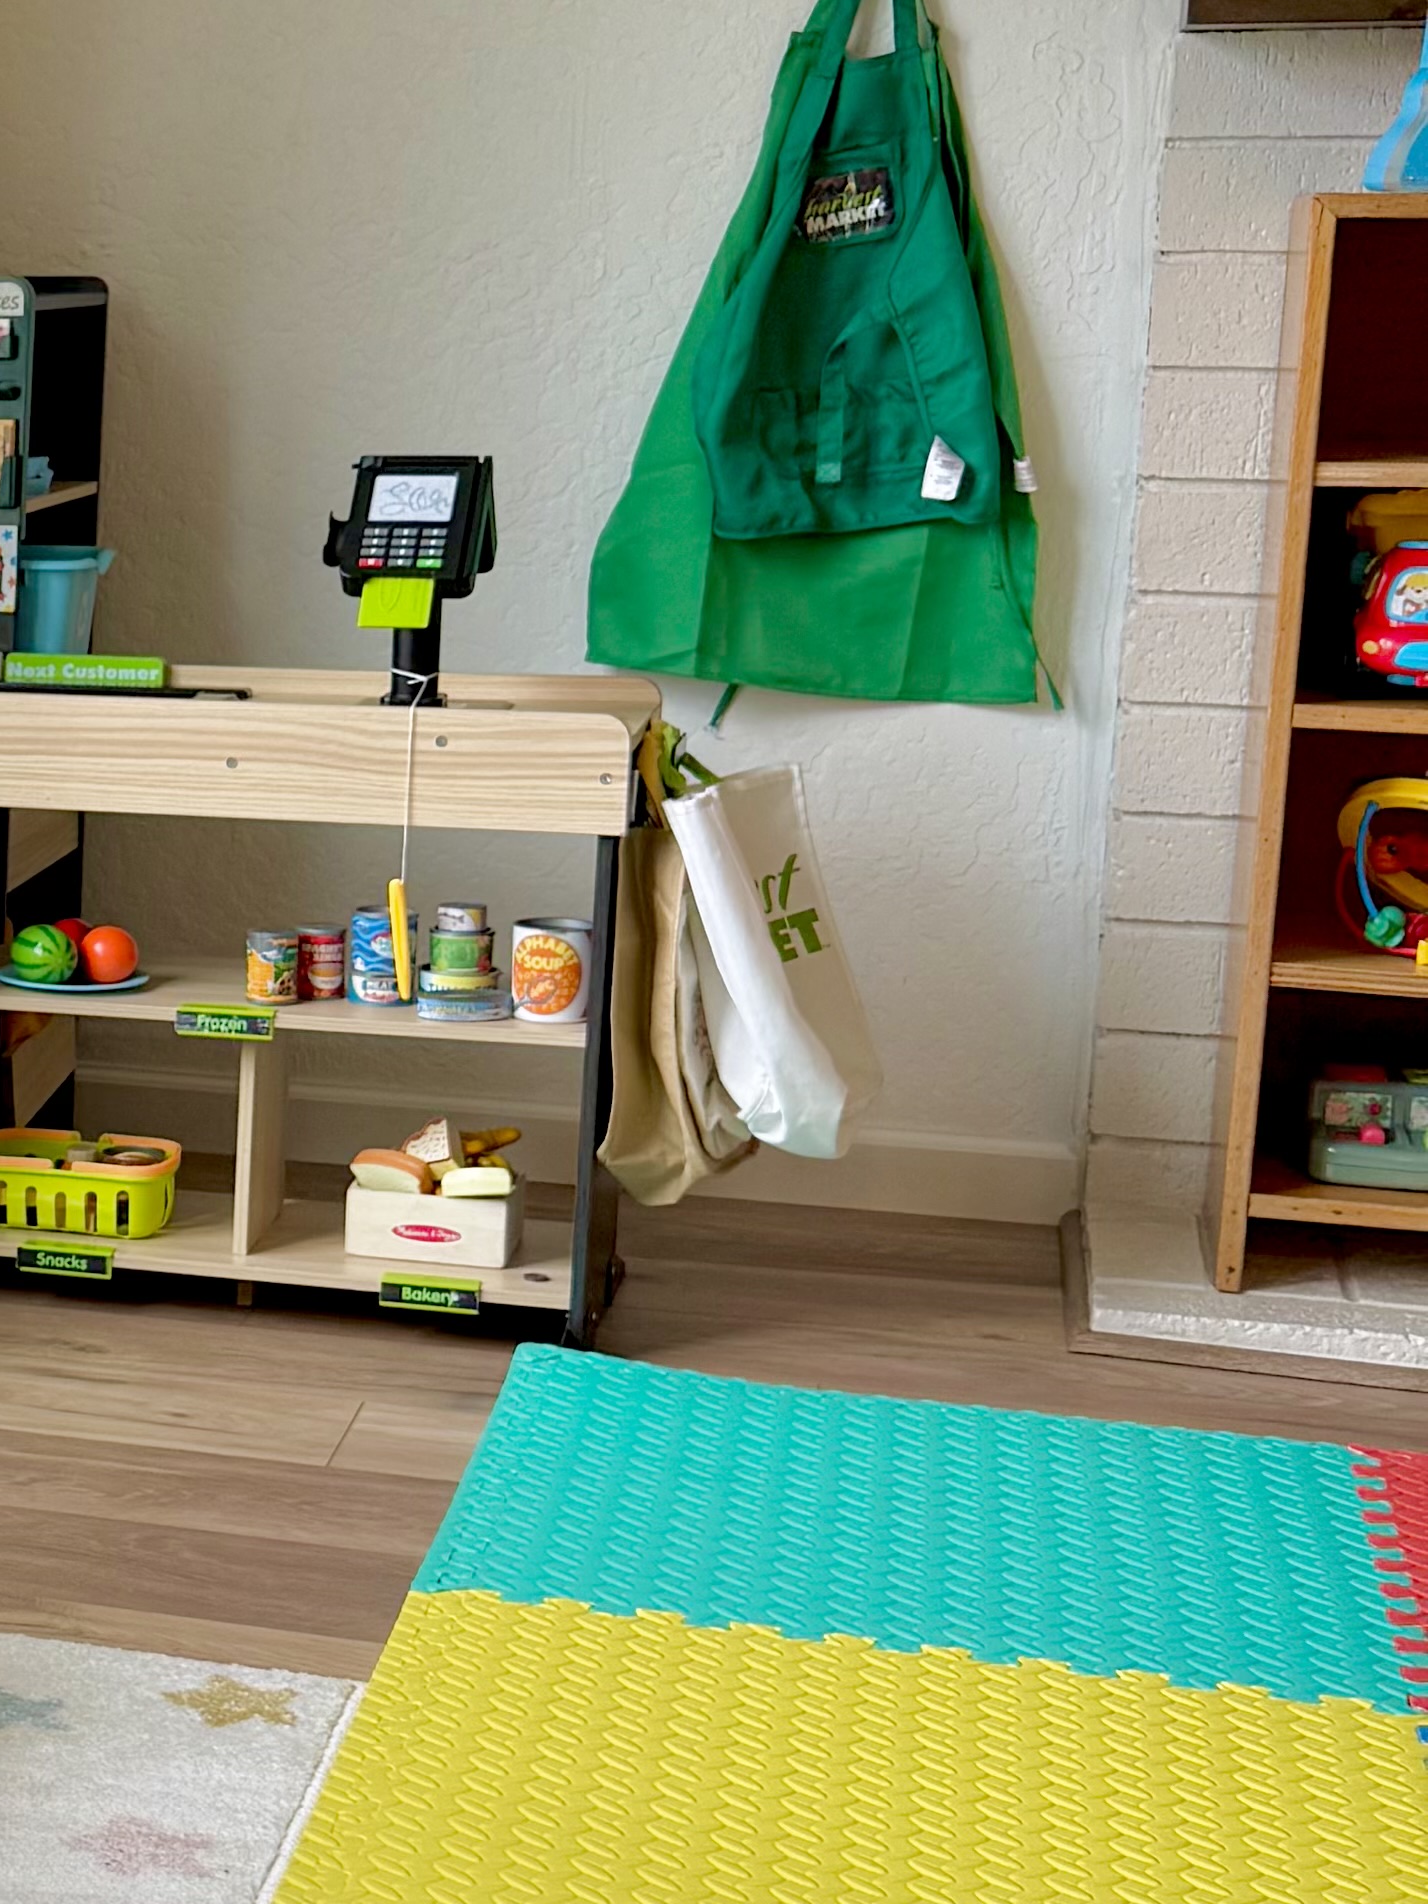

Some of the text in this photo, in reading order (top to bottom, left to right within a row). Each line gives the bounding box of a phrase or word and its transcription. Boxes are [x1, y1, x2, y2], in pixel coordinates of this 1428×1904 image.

[6, 661, 159, 681] Next Customer
[515, 936, 579, 965] ALPHABET
[523, 956, 565, 971] SOUP
[36, 1252, 88, 1271] Snacks
[401, 1286, 454, 1307] Bakery
